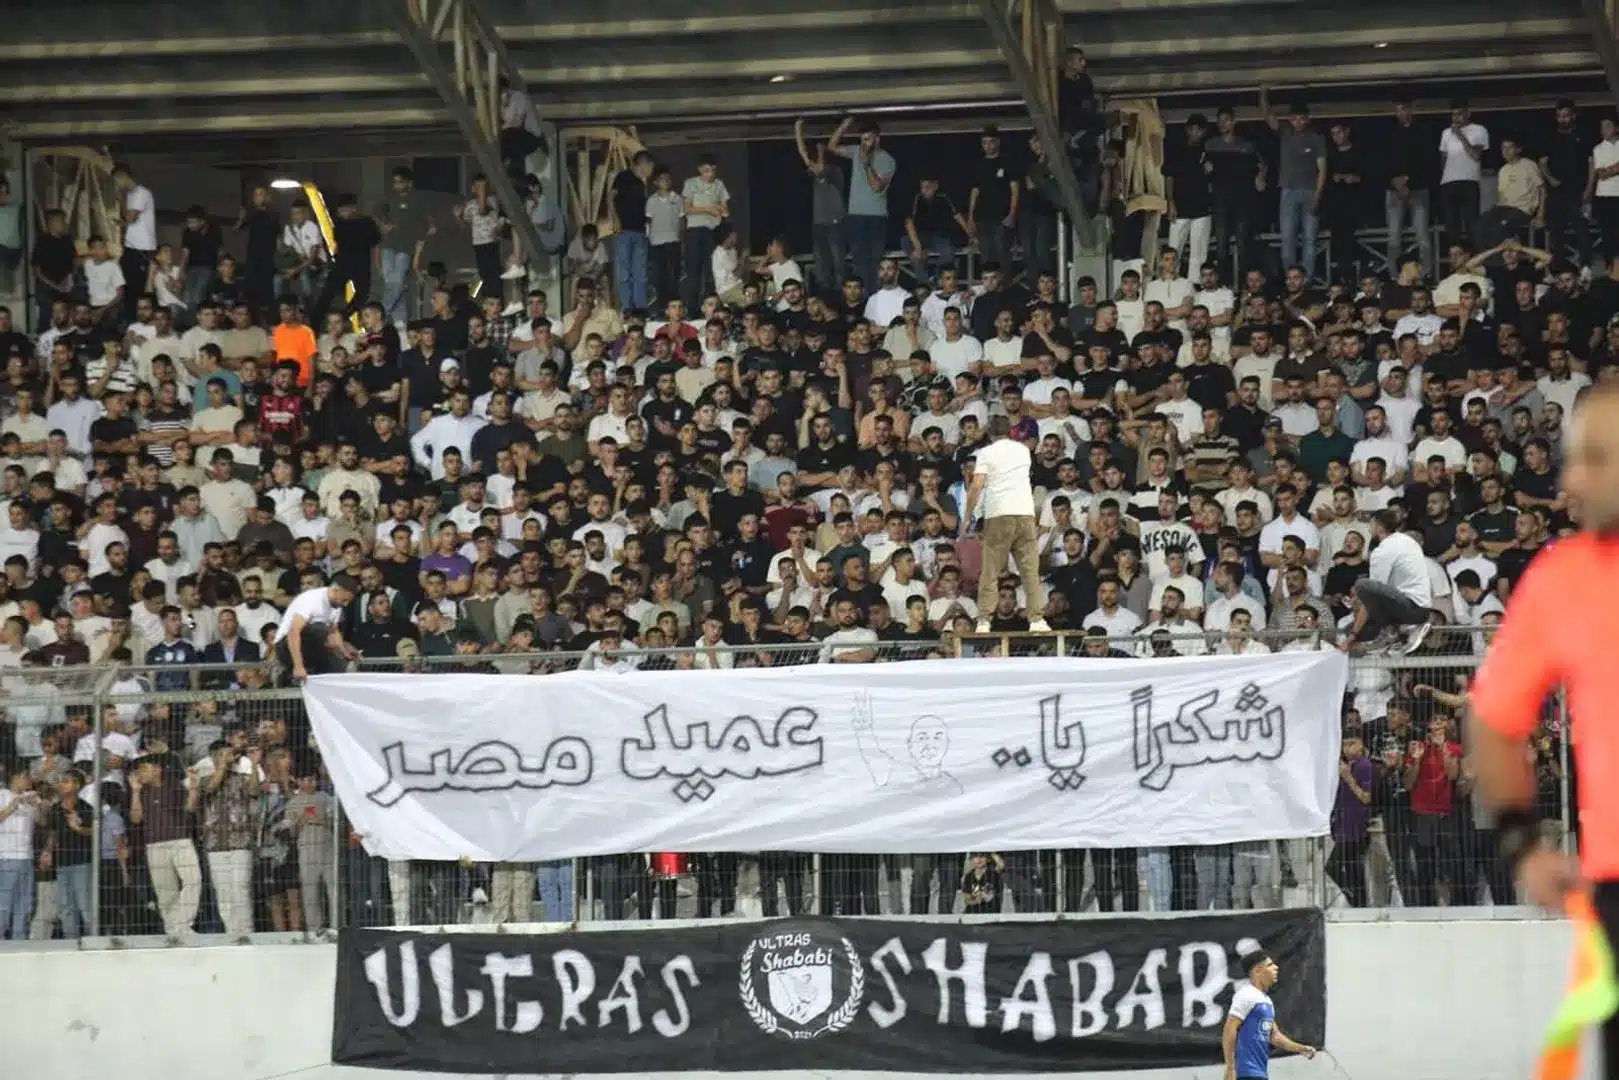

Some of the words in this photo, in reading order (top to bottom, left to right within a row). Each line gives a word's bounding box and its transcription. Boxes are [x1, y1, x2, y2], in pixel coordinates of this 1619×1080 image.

[365, 735, 593, 808] مصر
[620, 702, 825, 803] عميد
[1130, 682, 1285, 792] شكراً
[758, 932, 812, 950] ULTRAS
[760, 947, 833, 973] Shababi
[363, 939, 702, 1038] ULTRAS
